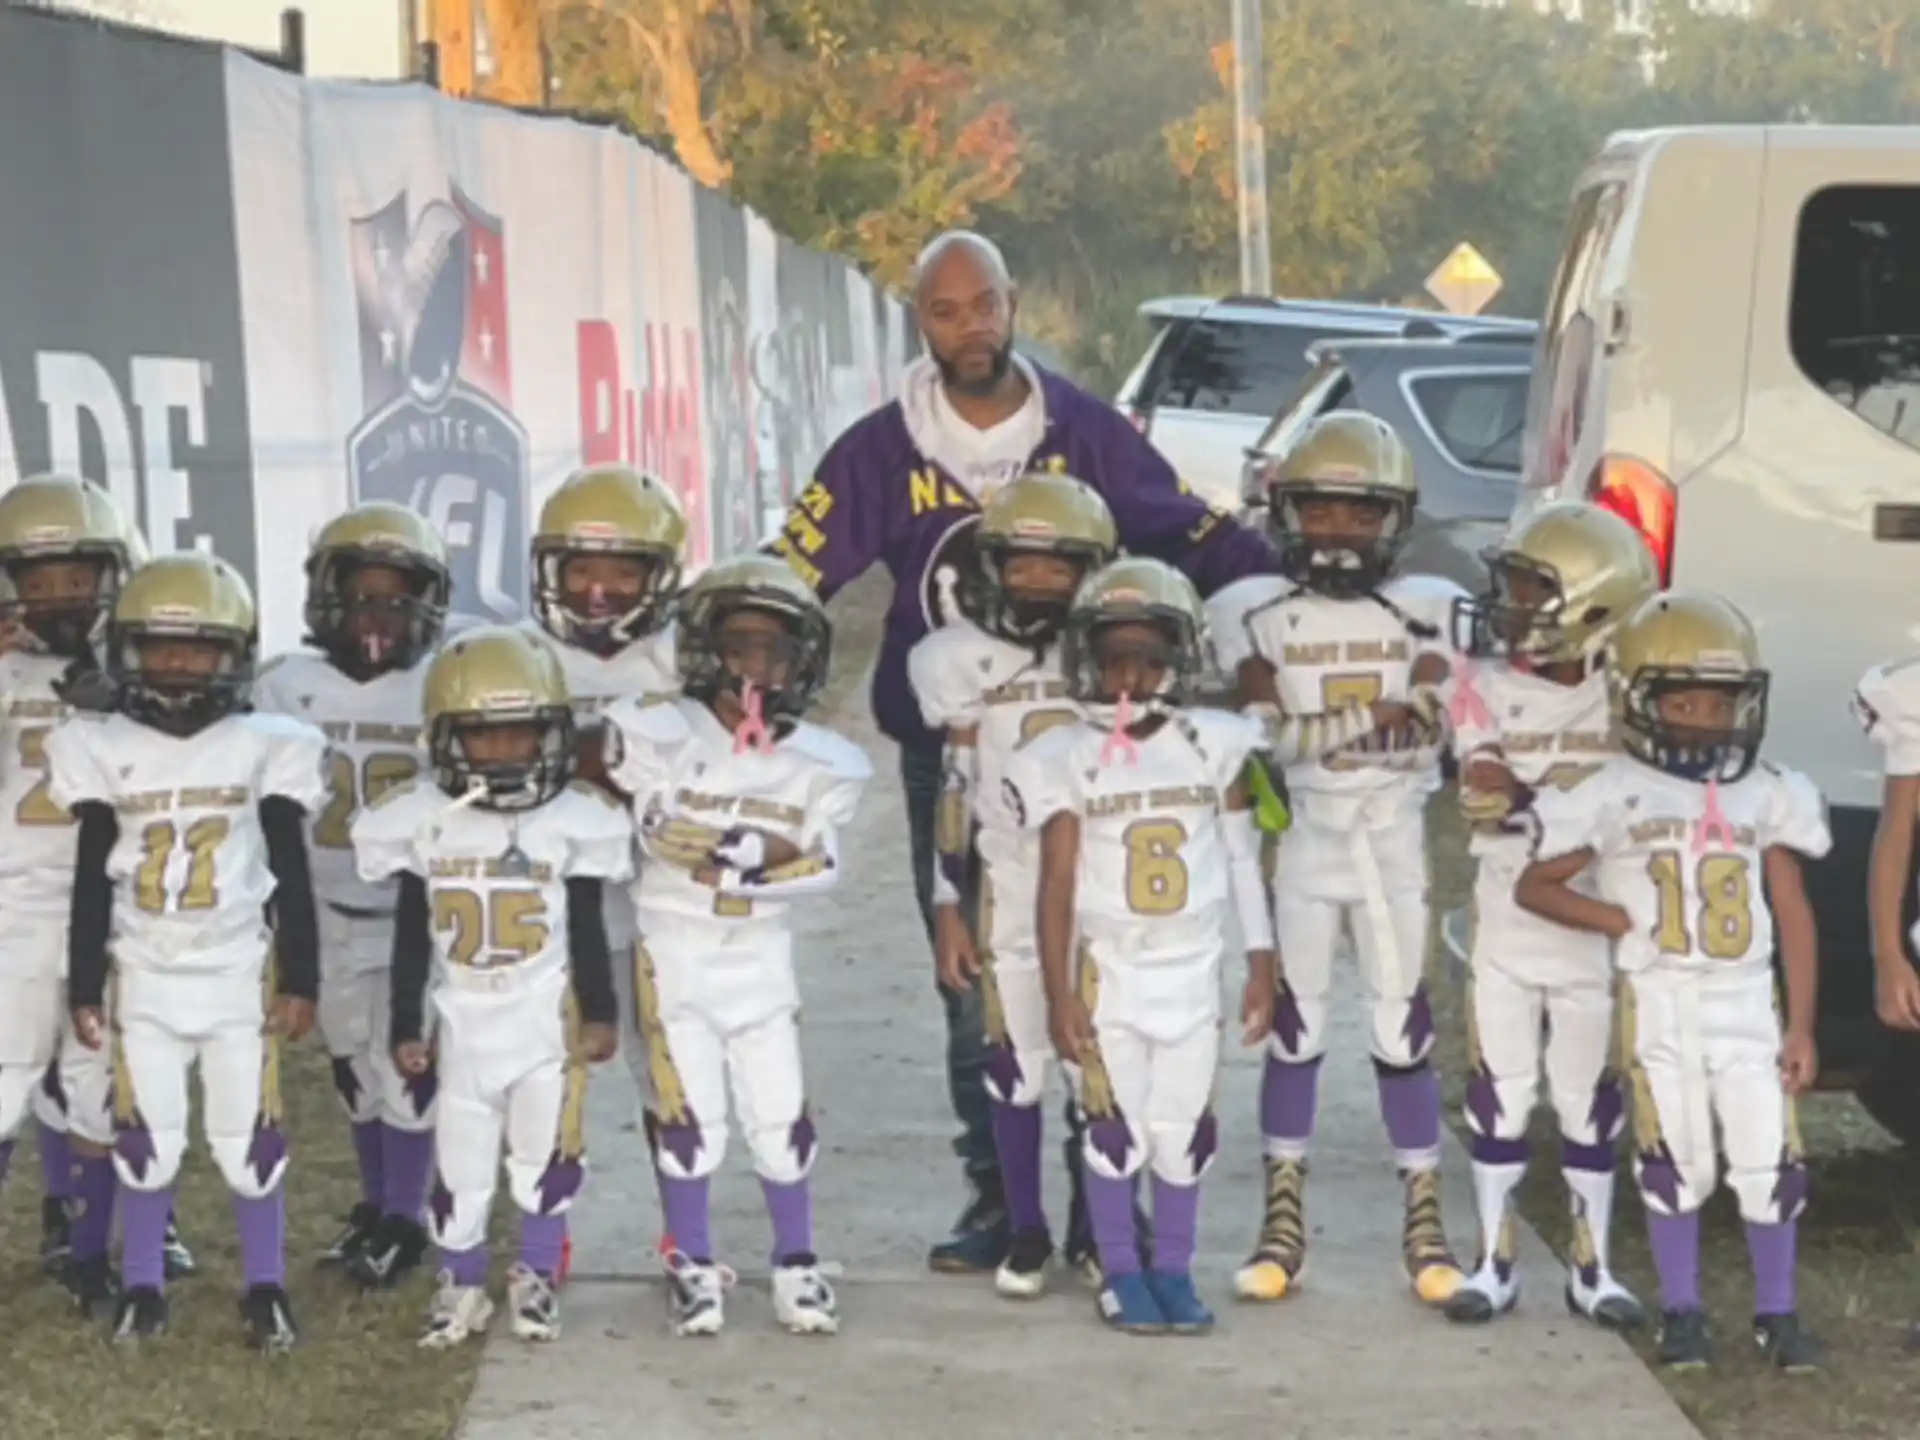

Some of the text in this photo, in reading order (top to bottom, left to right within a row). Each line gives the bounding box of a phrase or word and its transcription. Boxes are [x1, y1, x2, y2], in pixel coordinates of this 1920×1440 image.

[0, 350, 213, 560] DE
[133, 816, 231, 917] 11
[1121, 817, 1188, 917] 6
[1645, 849, 1753, 959] 18
[434, 887, 550, 968] 25
